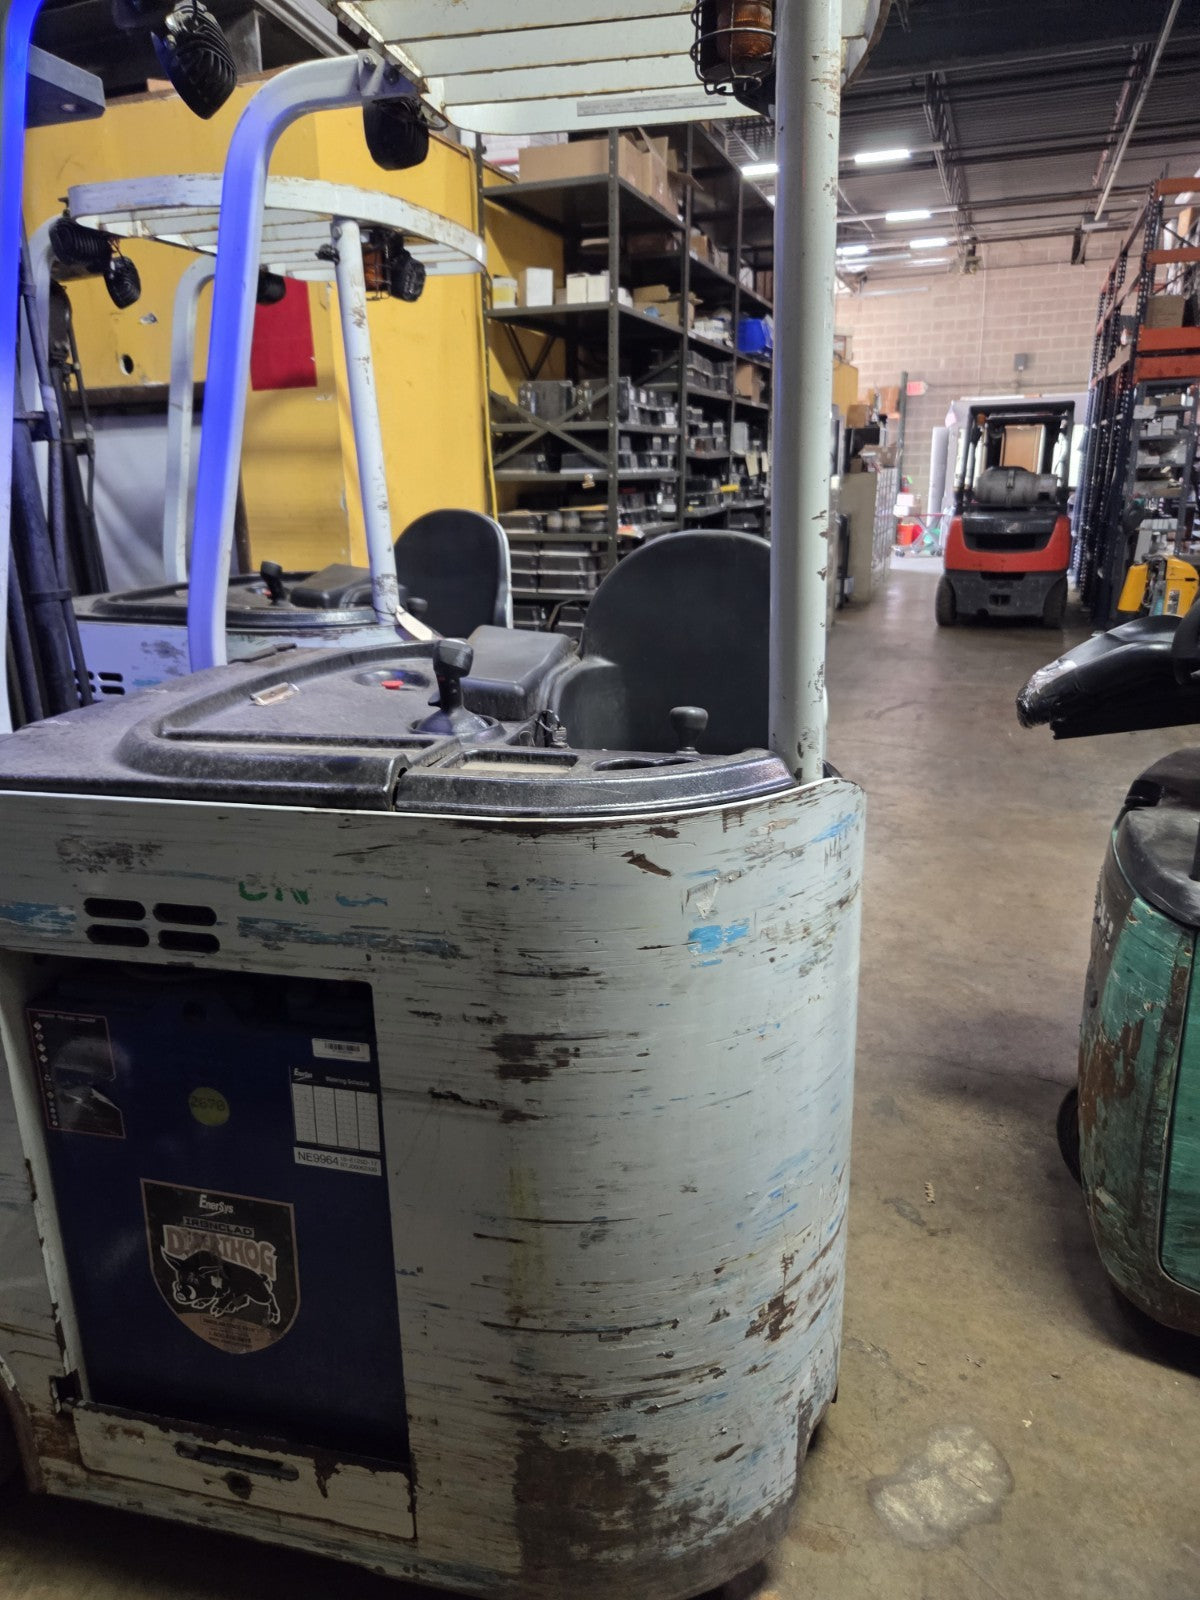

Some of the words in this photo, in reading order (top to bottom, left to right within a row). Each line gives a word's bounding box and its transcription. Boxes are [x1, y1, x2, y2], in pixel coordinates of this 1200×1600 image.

[298, 1151, 339, 1166] NE9964
[199, 1194, 234, 1215] EnerSys
[185, 1218, 253, 1236] IRONCLAD
